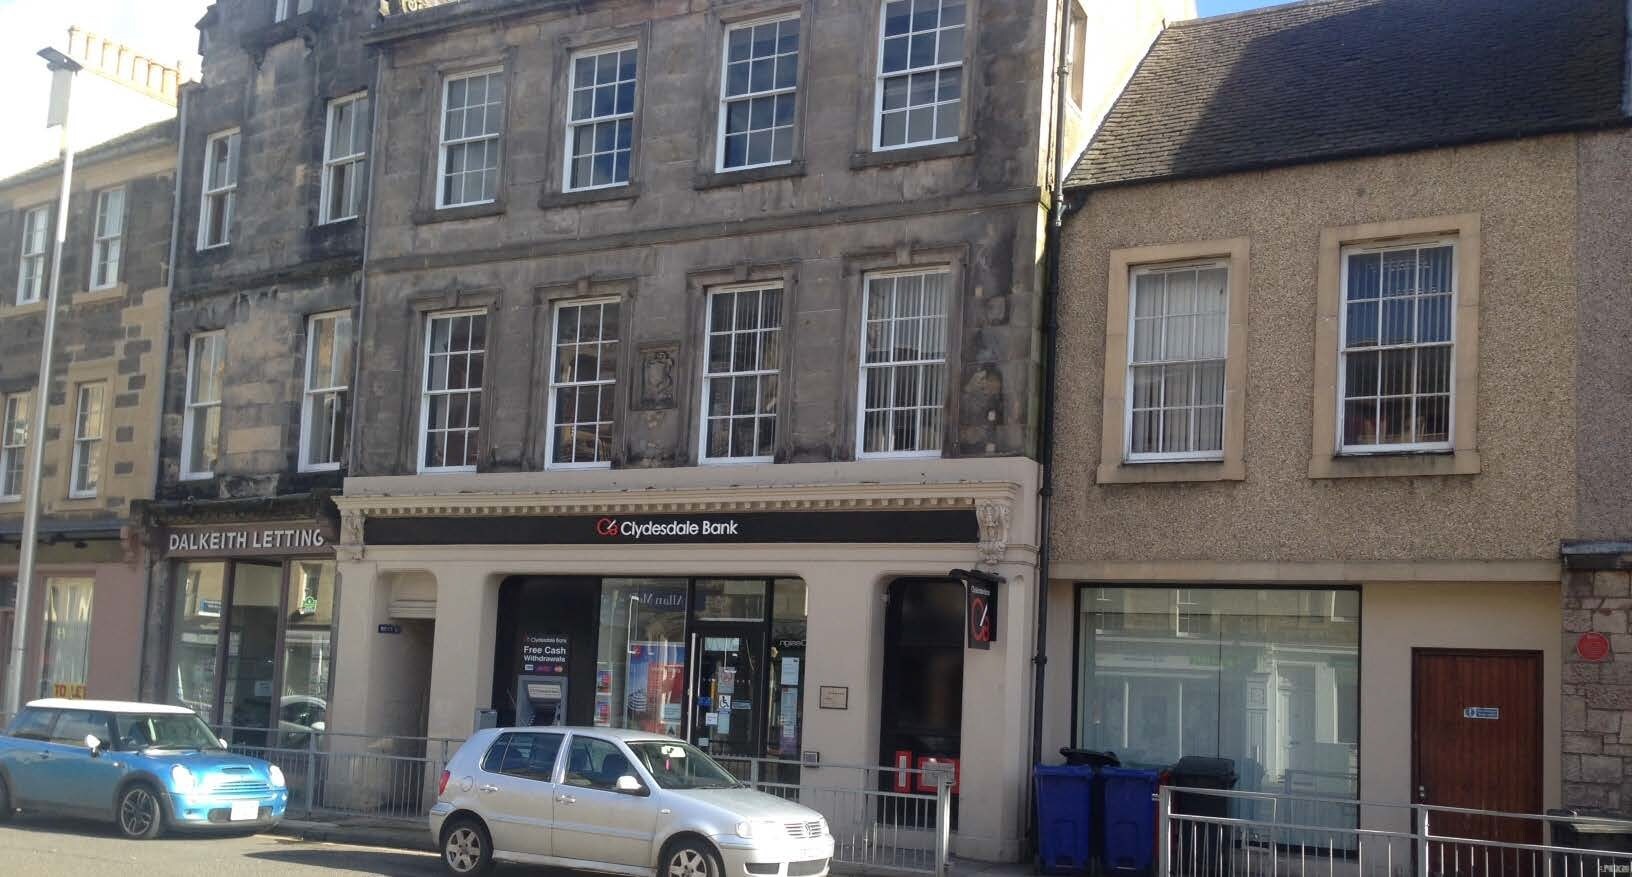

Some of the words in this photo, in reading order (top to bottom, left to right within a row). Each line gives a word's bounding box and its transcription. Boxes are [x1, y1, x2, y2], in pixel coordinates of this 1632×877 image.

[620, 520, 699, 538] Clydesdale
[702, 520, 738, 535] Bank
[169, 531, 247, 550] DALKEITH
[252, 529, 324, 548] LETTING
[523, 645, 543, 654] Free
[544, 646, 566, 655] Cash
[523, 655, 566, 663] Withdrawals
